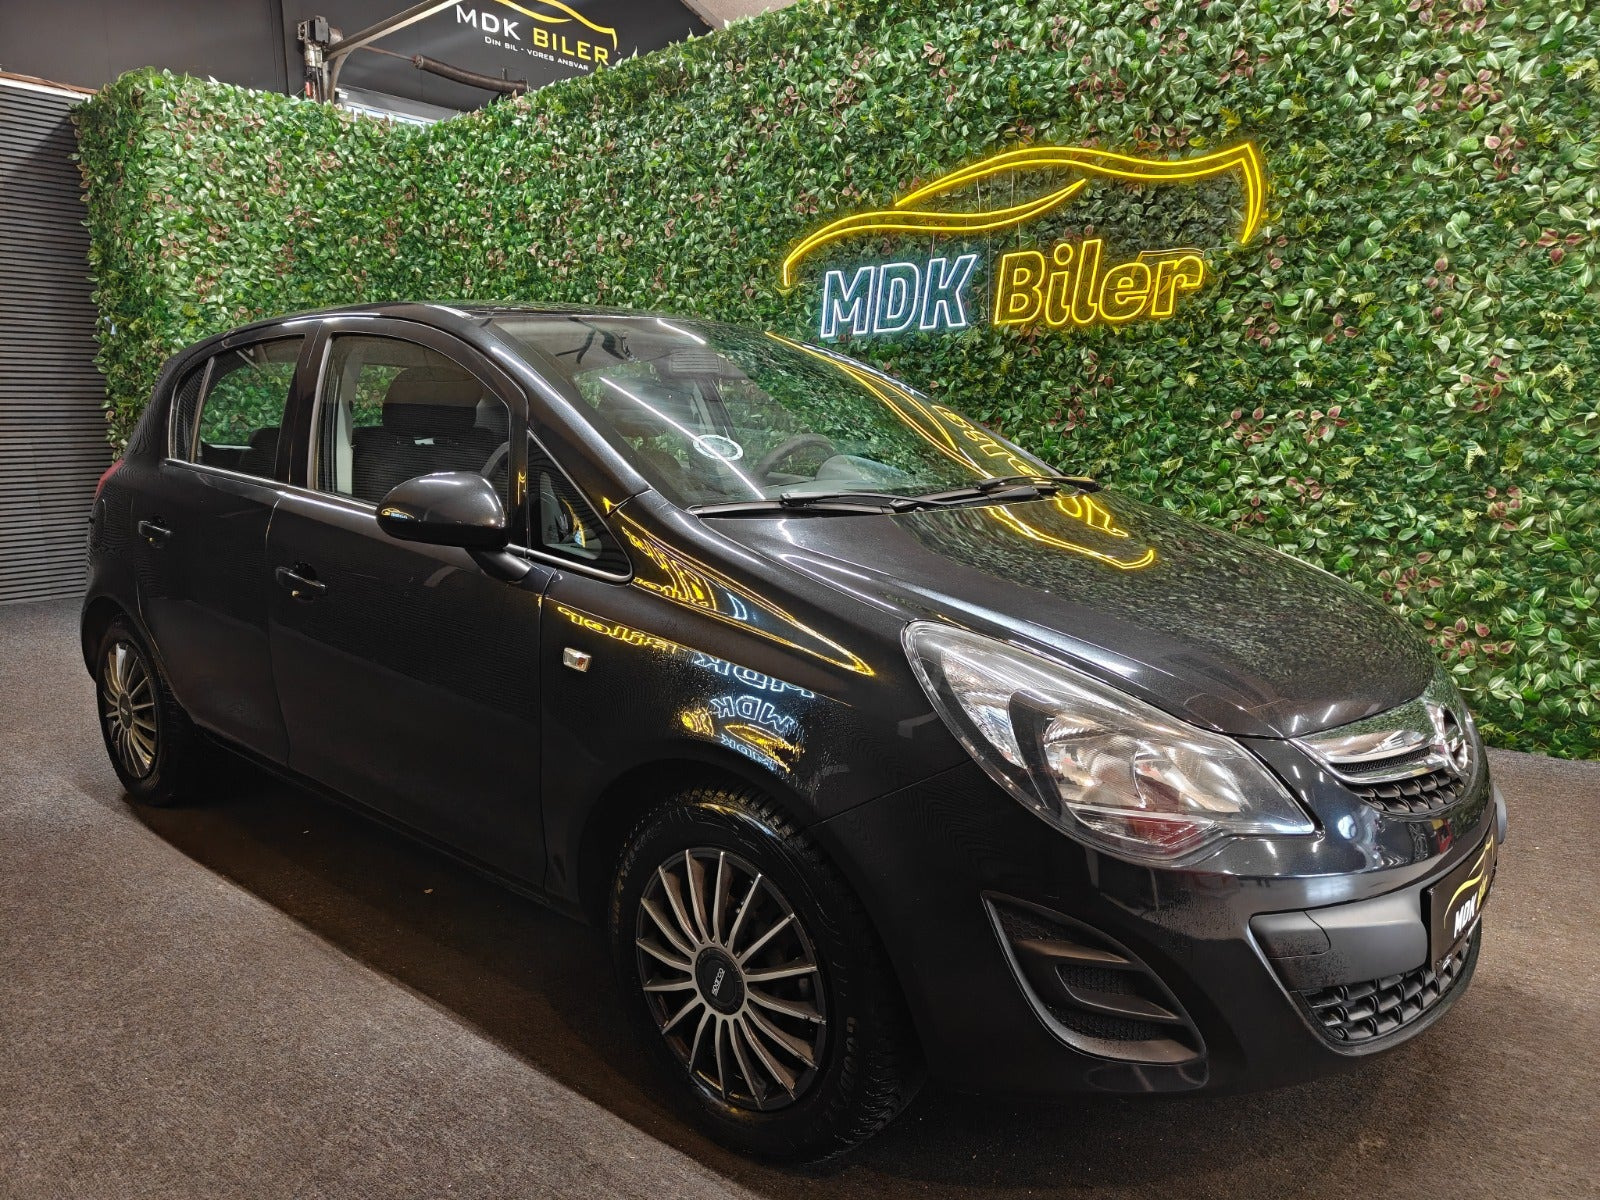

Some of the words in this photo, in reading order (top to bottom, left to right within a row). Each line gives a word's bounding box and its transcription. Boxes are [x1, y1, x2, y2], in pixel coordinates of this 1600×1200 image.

[456, 4, 521, 41] MDK
[533, 27, 609, 66] BILER
[484, 35, 502, 47] DIN
[504, 42, 519, 52] BIL
[526, 48, 555, 62] VORES
[557, 57, 589, 71] ANSVAR
[821, 254, 979, 338] MDK
[994, 239, 1206, 326] Biler
